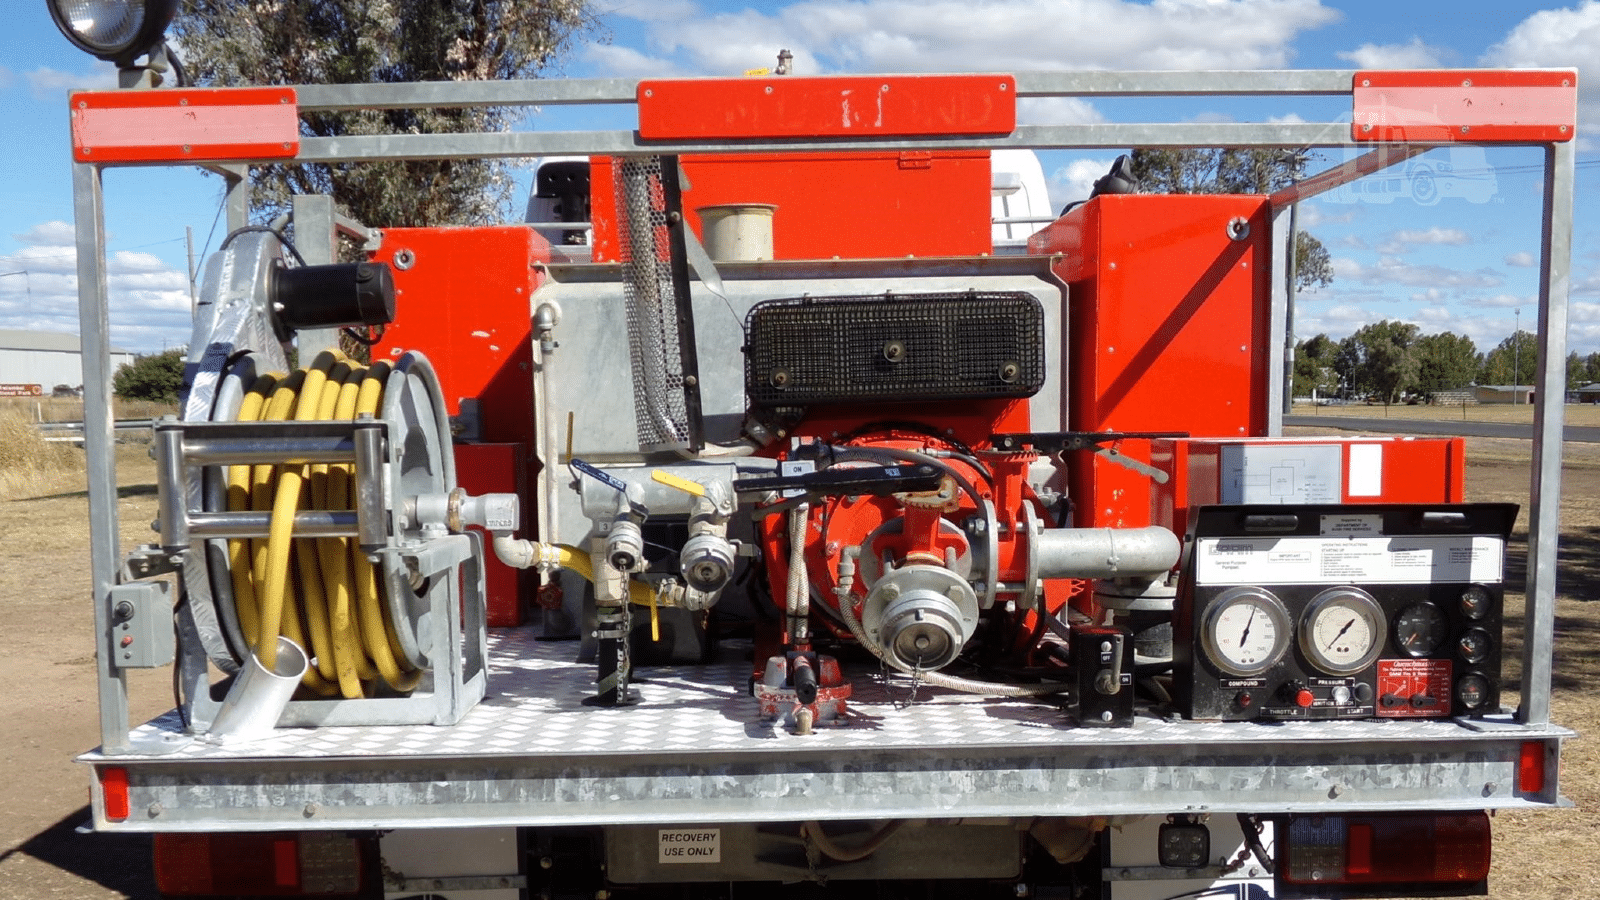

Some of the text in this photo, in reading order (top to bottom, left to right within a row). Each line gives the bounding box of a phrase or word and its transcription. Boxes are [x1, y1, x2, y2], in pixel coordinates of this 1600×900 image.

[662, 833, 716, 842] RECOVERY
[664, 847, 714, 856] USE ONLY
